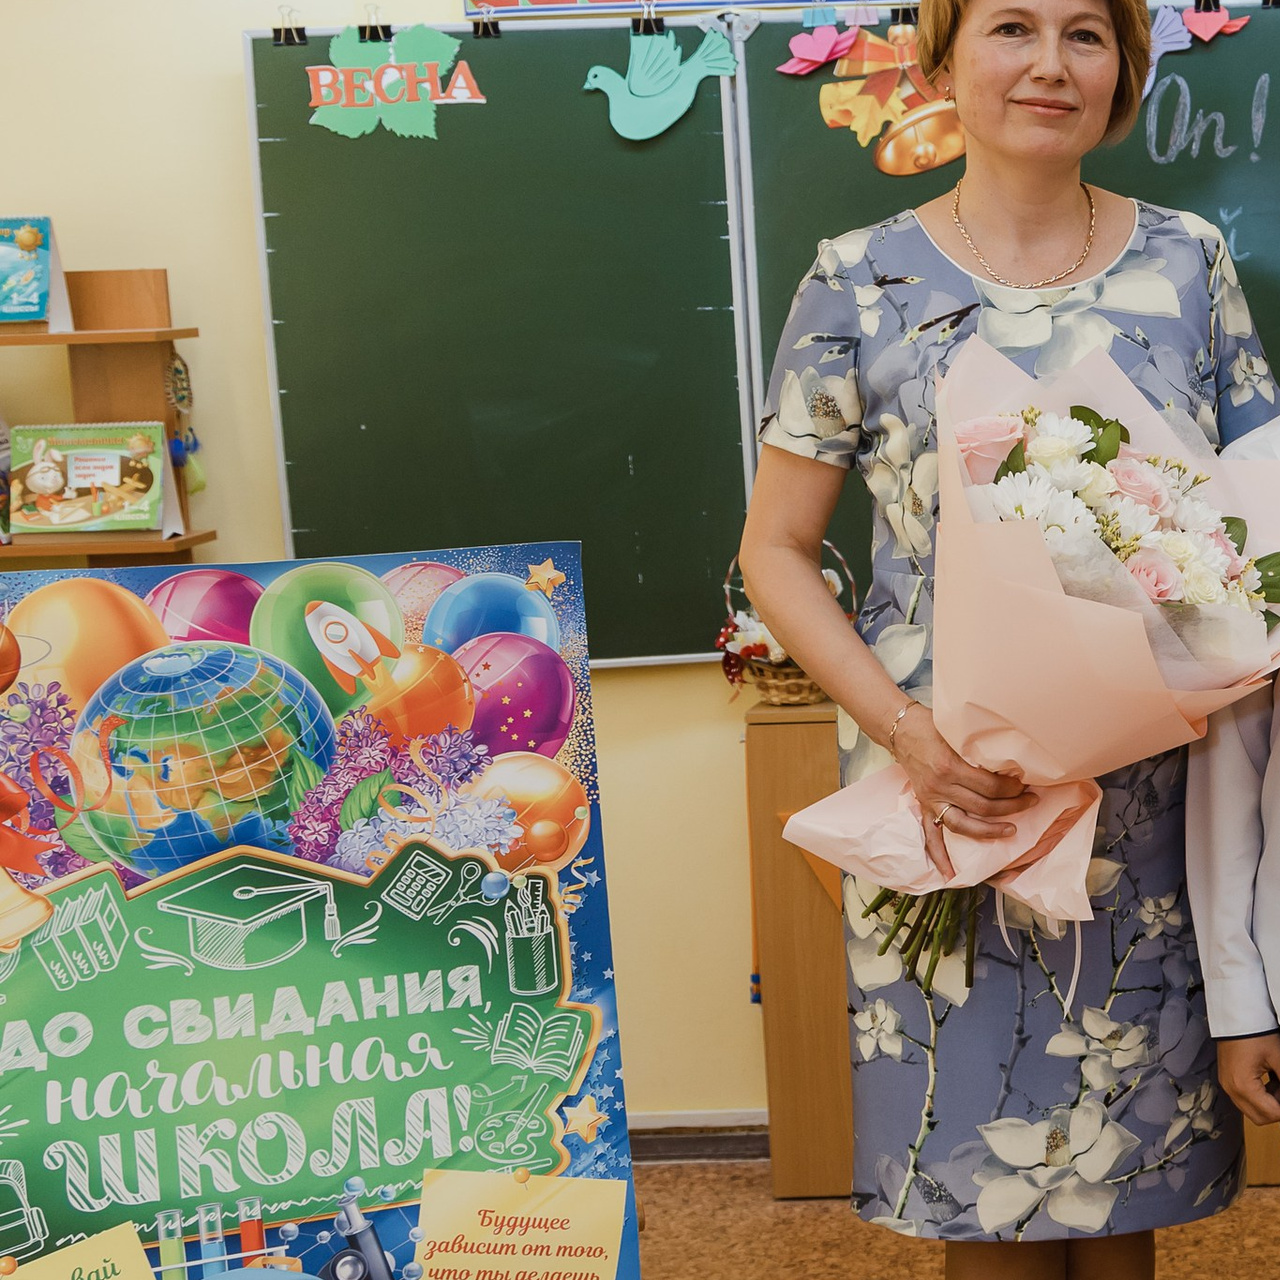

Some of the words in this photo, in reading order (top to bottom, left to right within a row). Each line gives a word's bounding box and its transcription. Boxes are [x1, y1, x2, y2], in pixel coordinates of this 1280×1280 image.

[305, 61, 487, 108] ВЕСНА
[0, 1012, 94, 1075] ДО
[123, 965, 492, 1050] СВИДАНИЯ,
[45, 1032, 454, 1124] начальная
[43, 1085, 475, 1213] ШКОЛА!
[478, 1209, 570, 1236] Будущее
[424, 1234, 517, 1260] зависит
[521, 1243, 551, 1256] от
[556, 1244, 609, 1260] того,
[428, 1268, 472, 1280] что
